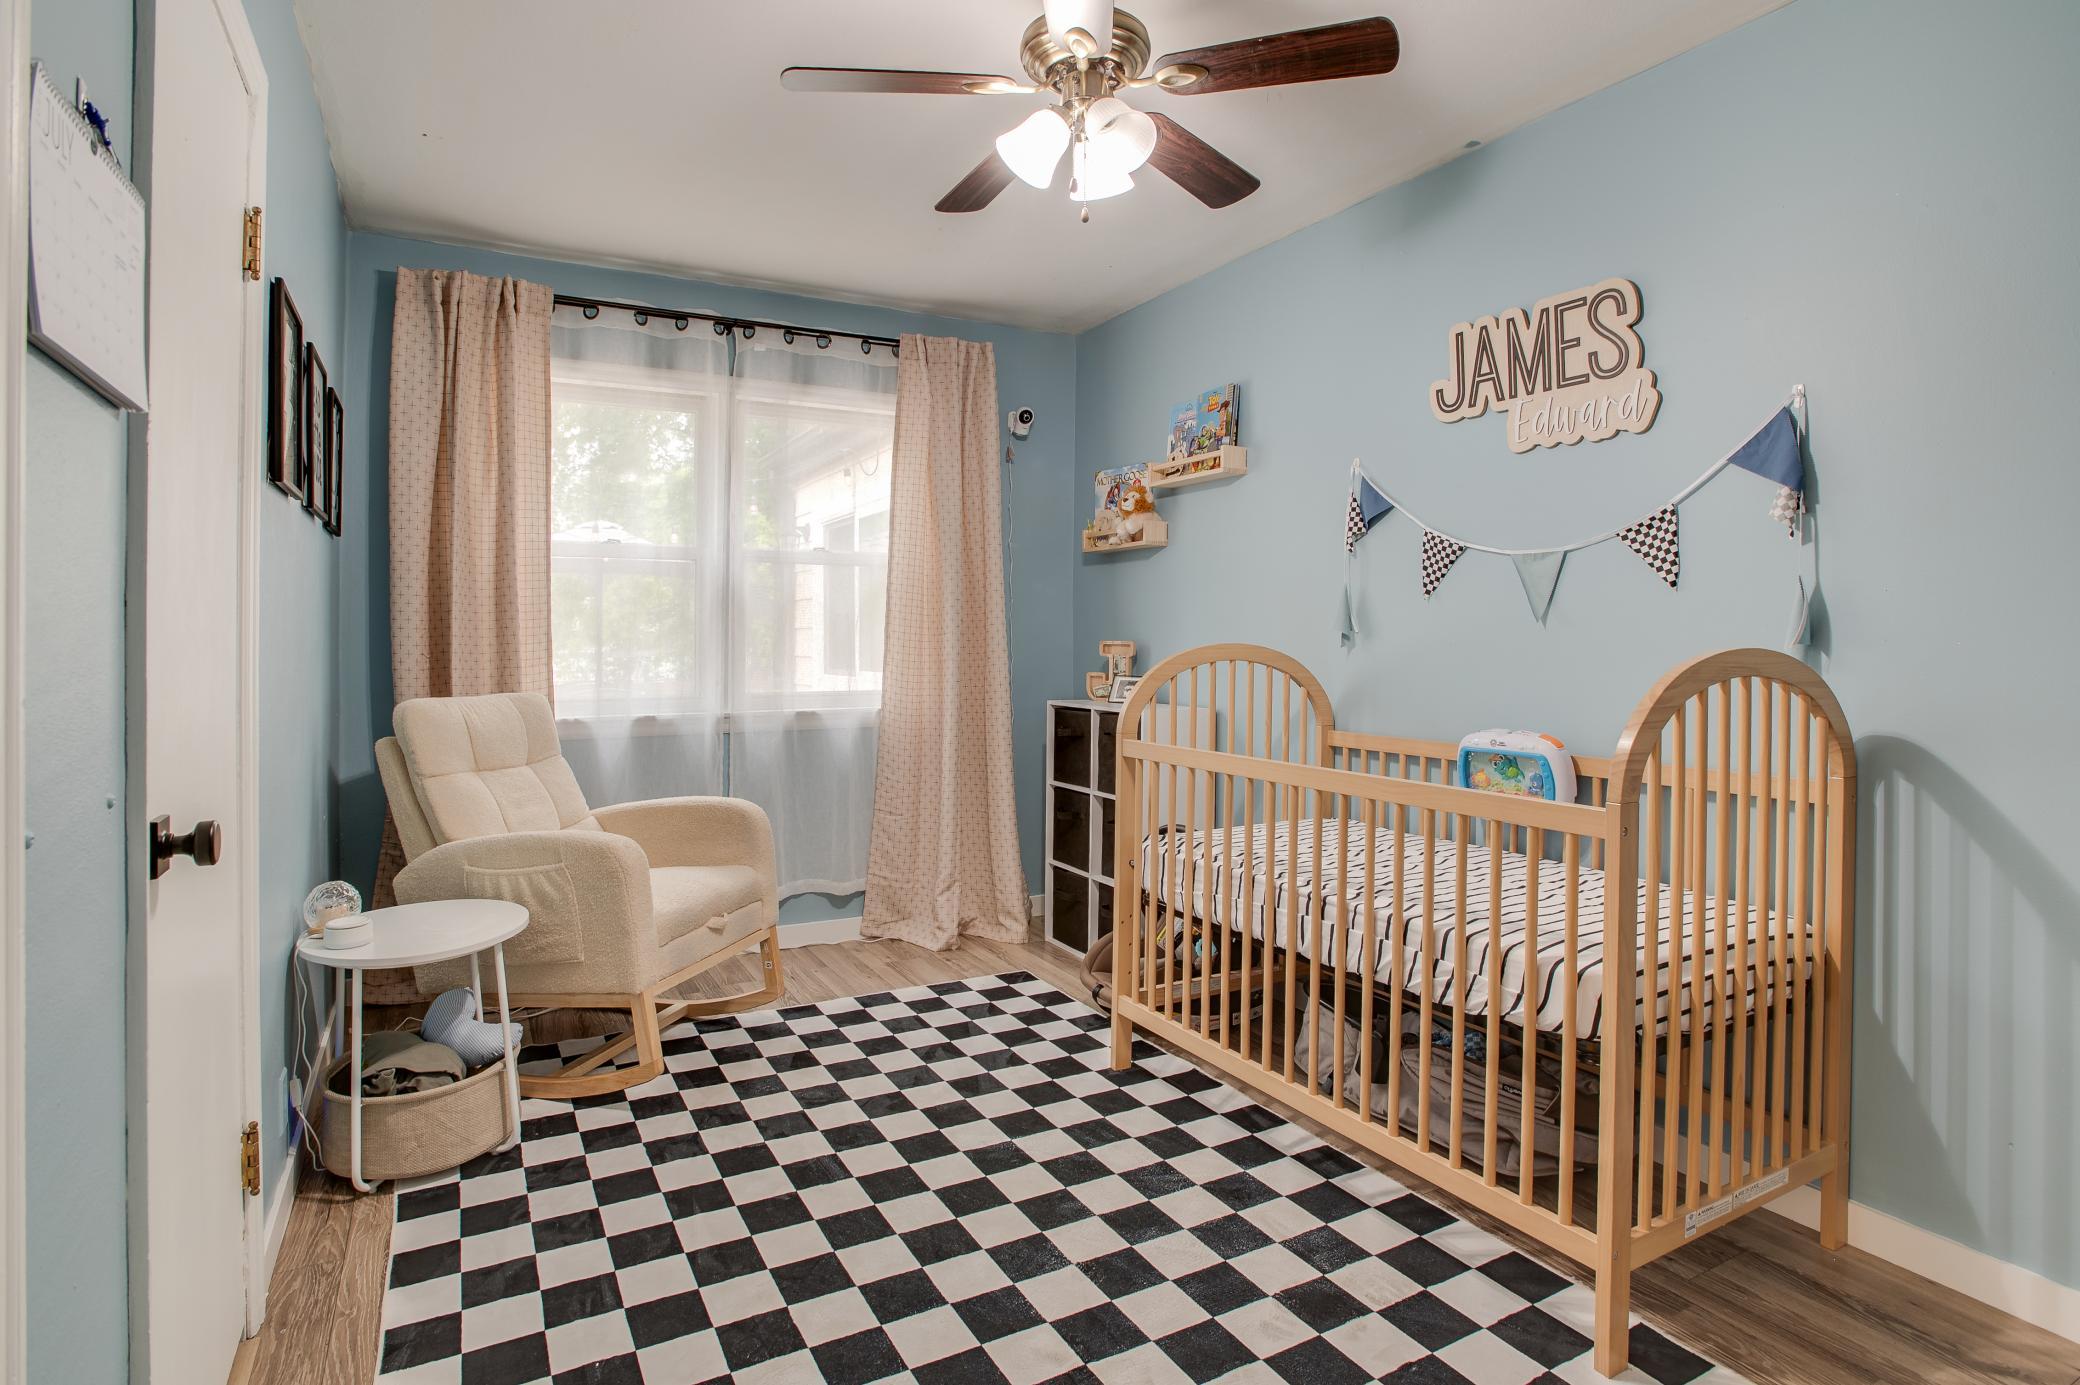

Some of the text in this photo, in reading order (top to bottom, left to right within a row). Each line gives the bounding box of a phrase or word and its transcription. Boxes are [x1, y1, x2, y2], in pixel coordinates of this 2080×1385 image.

[43, 97, 75, 165] JULY
[1435, 288, 1630, 414] JAMES
[1513, 378, 1648, 443] Edward
